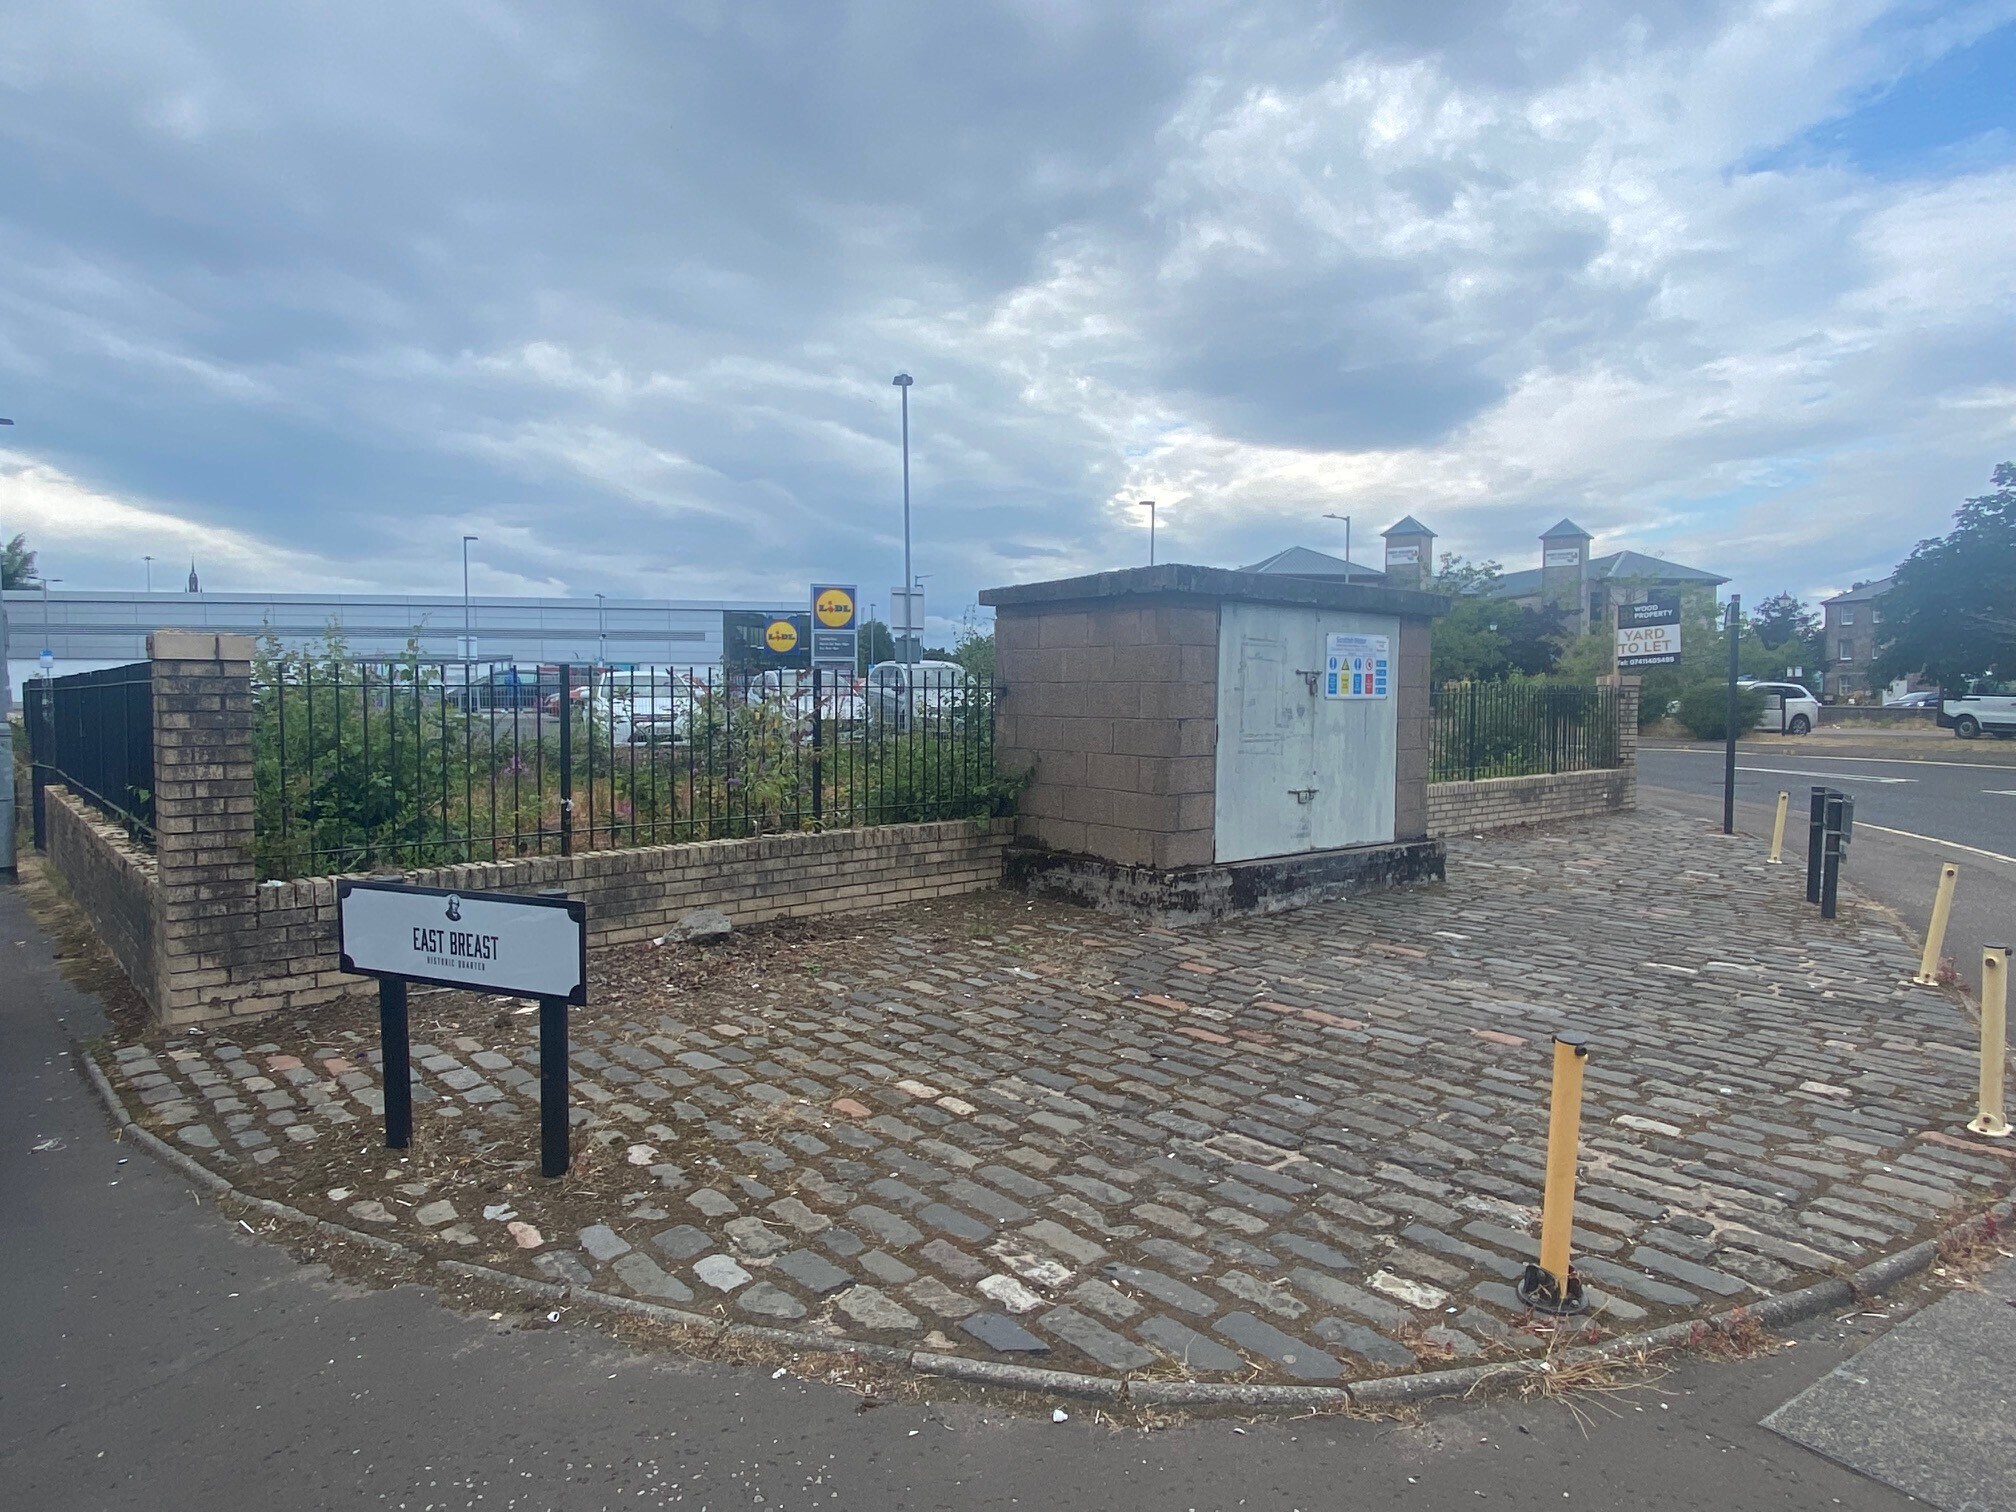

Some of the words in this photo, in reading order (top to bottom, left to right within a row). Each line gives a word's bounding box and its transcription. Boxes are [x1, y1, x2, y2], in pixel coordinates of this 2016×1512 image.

[1634, 610, 1673, 619] PROPERTY
[1624, 628, 1665, 641] YARD
[1618, 643, 1639, 654] TO
[1644, 640, 1671, 652] LET
[413, 927, 444, 953] EAST
[450, 931, 499, 960] BREAST
[426, 956, 455, 967] HISTORIC
[458, 959, 485, 971] QUARTER
